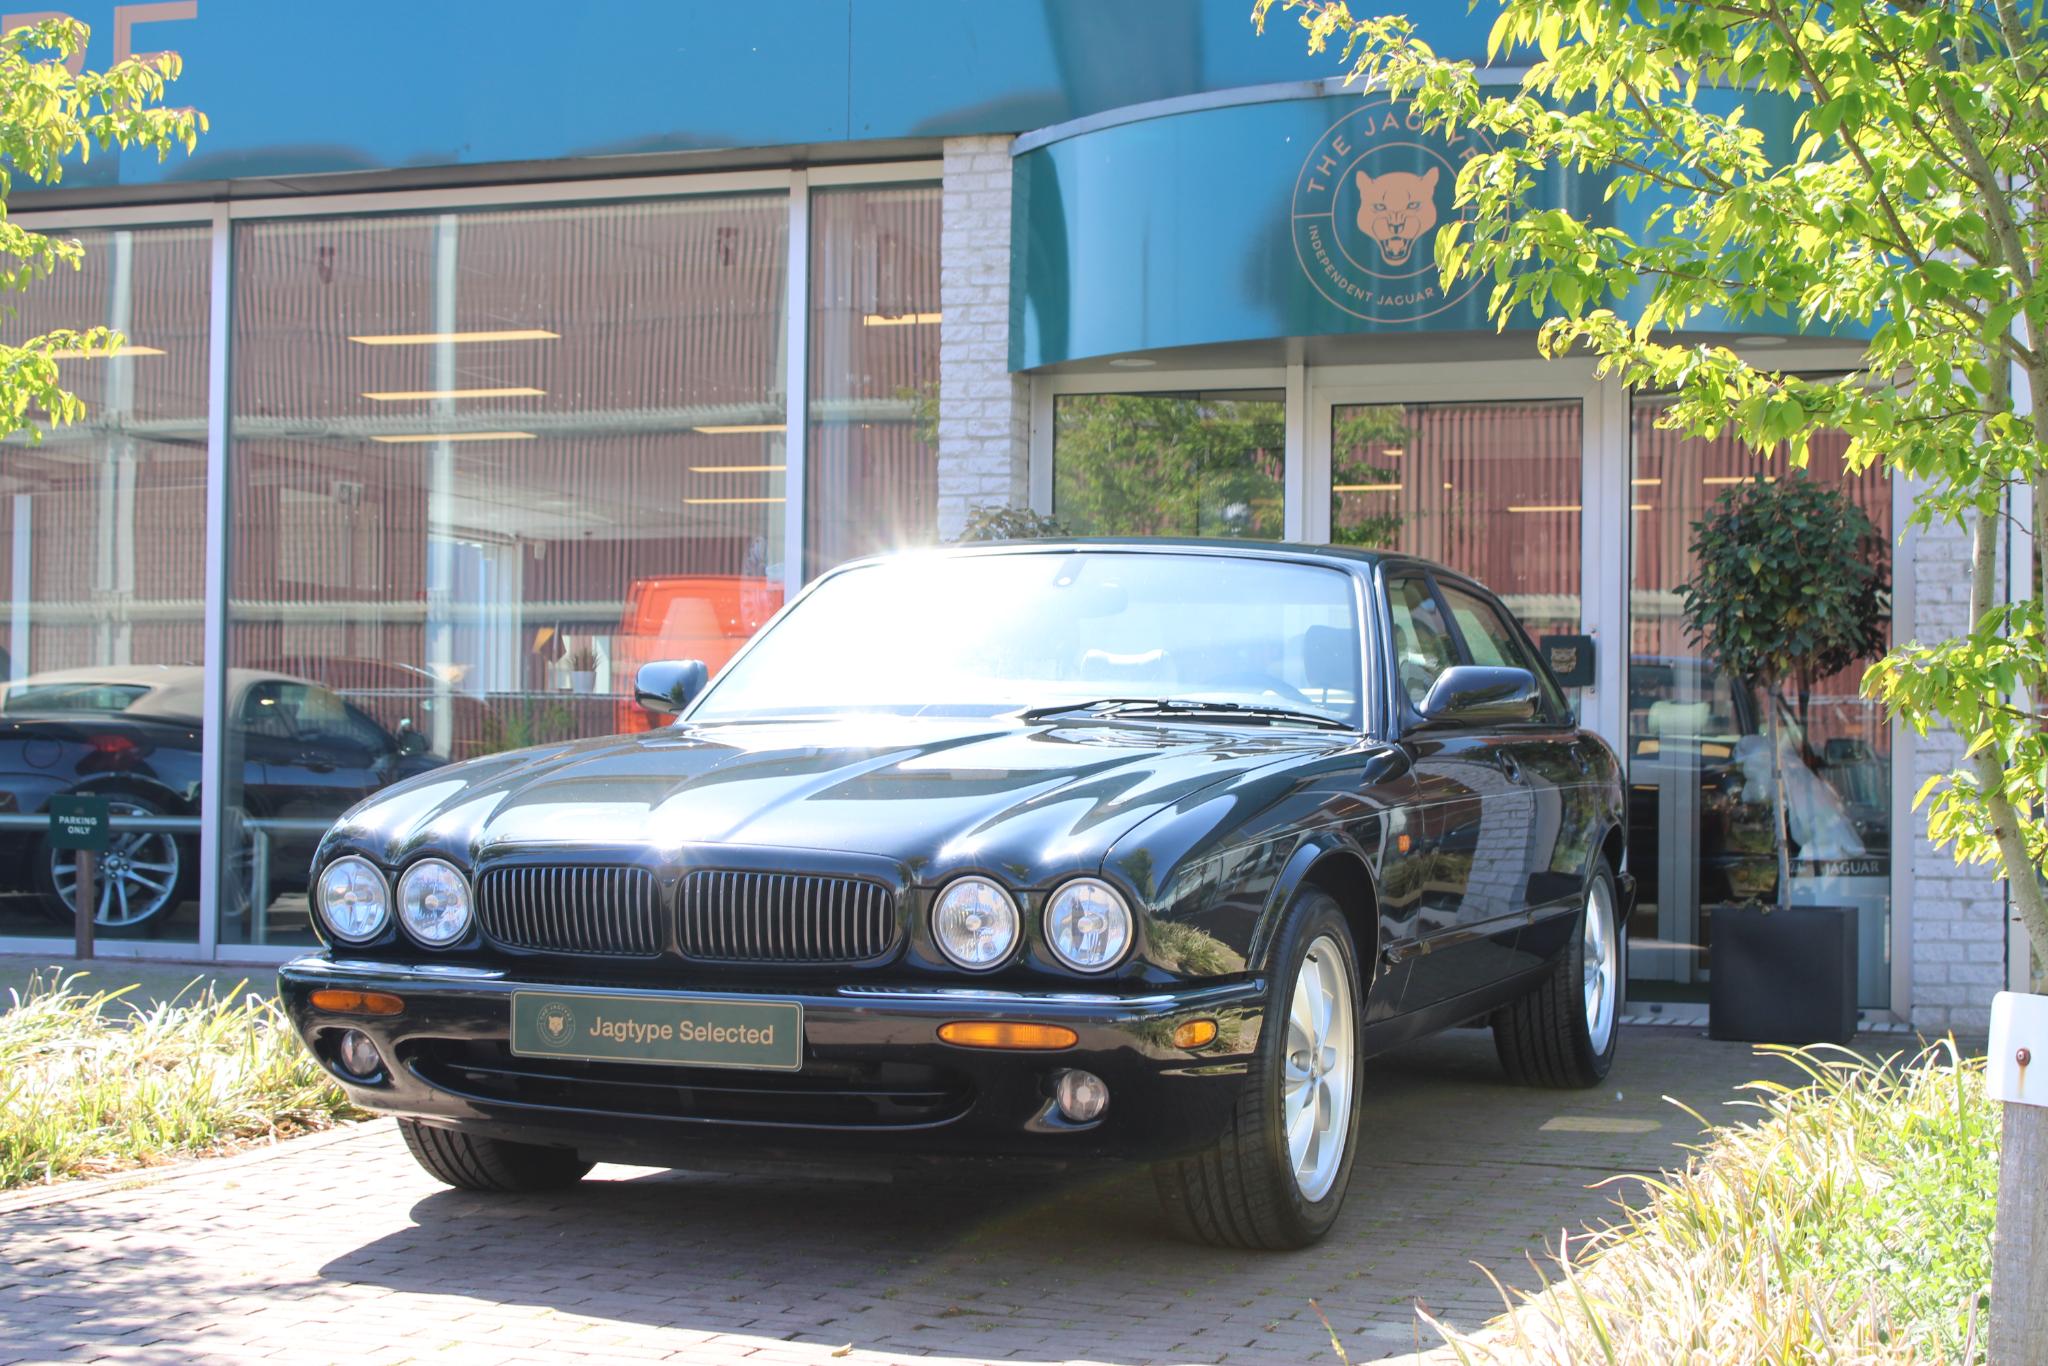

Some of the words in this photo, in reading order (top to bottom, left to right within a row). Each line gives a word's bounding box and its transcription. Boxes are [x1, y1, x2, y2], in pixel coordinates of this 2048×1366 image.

[1307, 135, 1352, 193] THE
[1363, 111, 1479, 184] JAGTYP
[1308, 225, 1374, 302] INDEPENDENT
[1377, 287, 1435, 306] JAGUAR
[58, 815, 98, 826] PARKING
[67, 826, 91, 835] ONLY
[1825, 860, 1880, 875] JAGUAR
[589, 1016, 673, 1043] Jagtype
[679, 1020, 774, 1045] Selected
